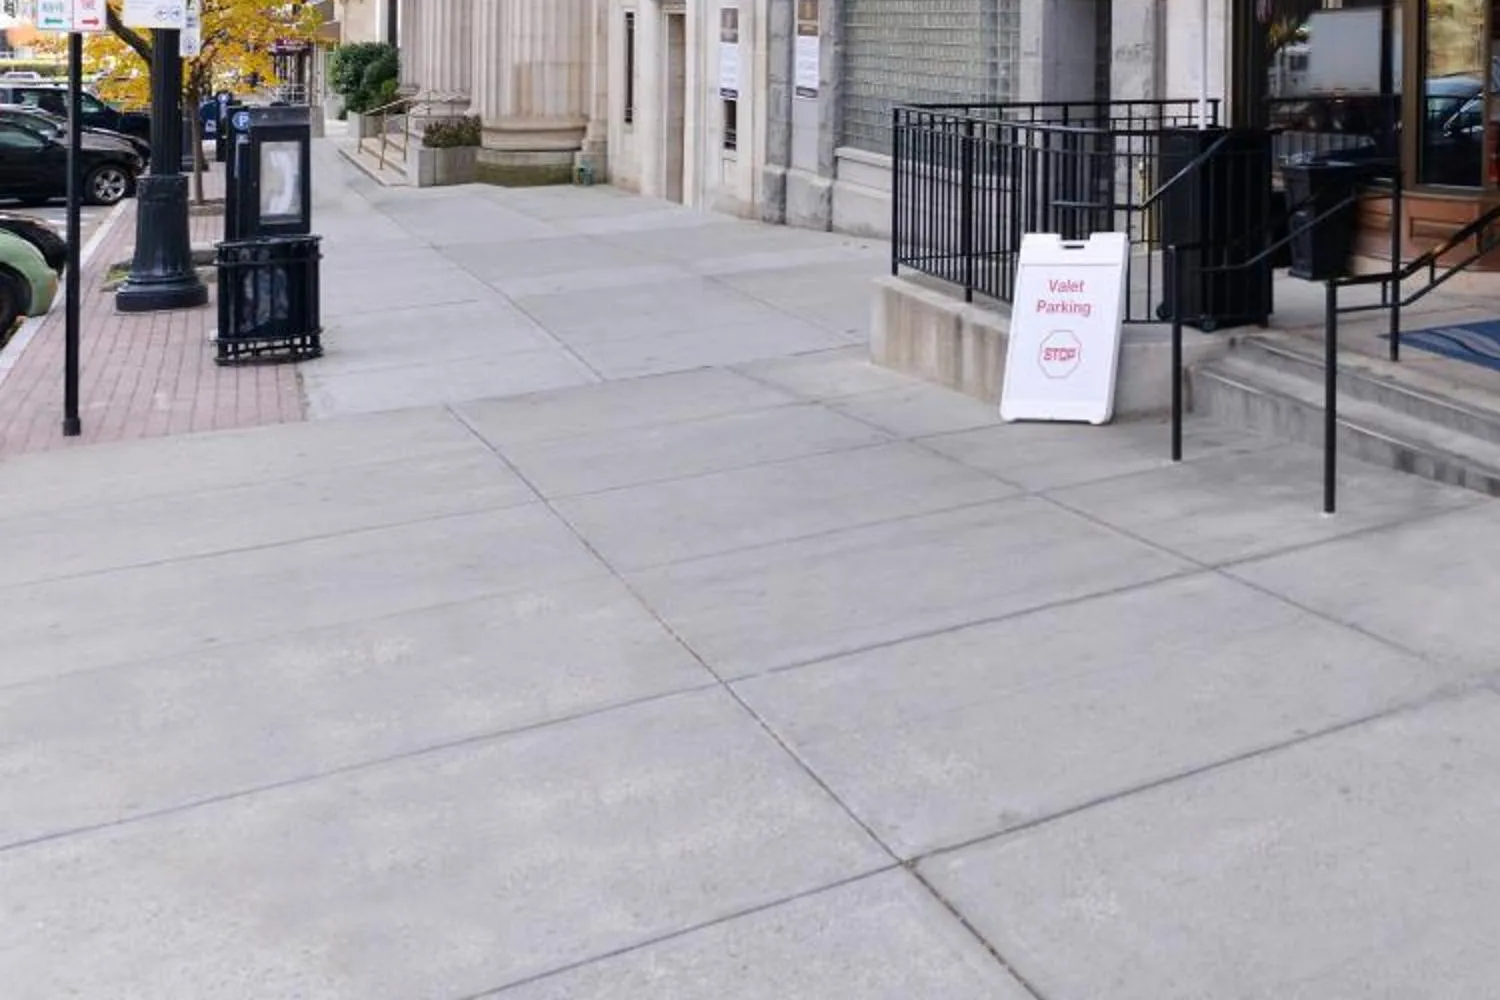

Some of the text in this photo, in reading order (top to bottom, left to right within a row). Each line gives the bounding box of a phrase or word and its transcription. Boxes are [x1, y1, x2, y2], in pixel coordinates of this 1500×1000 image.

[1048, 279, 1085, 293] Valet
[1036, 299, 1091, 317] Parking
[1043, 347, 1077, 361] STOP
